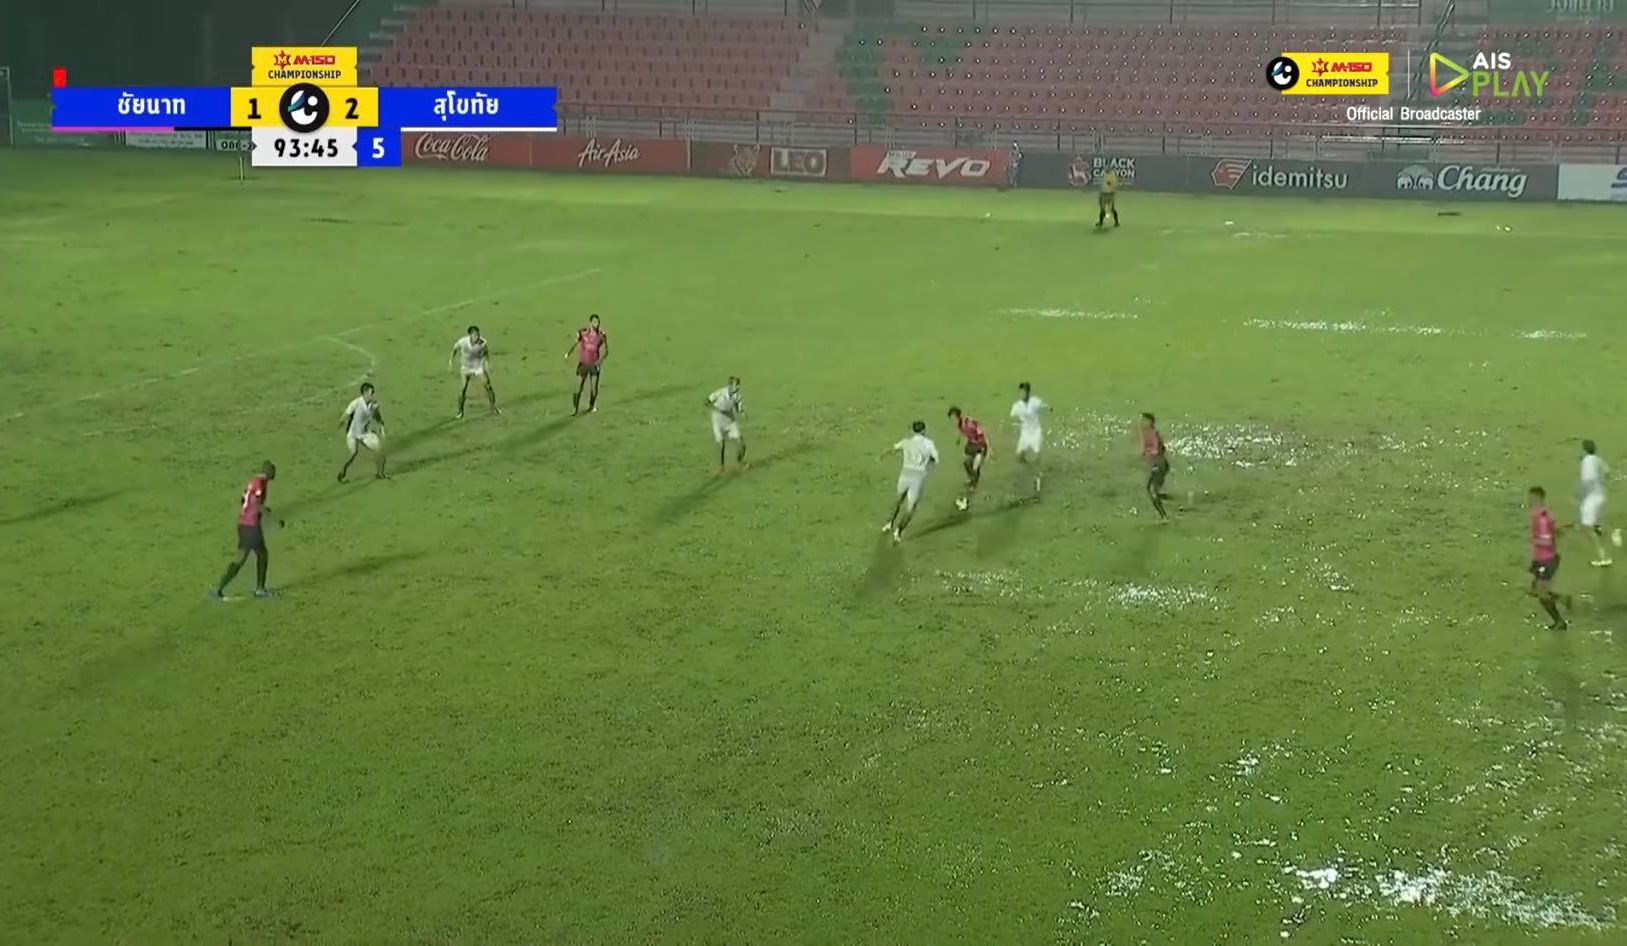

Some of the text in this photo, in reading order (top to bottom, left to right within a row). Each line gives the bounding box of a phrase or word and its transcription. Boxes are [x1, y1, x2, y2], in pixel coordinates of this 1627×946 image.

[773, 149, 825, 174] LEO
[1093, 158, 1135, 168] BLACK
[1252, 165, 1348, 189] idemitsu
[1437, 165, 1527, 198] Chang
